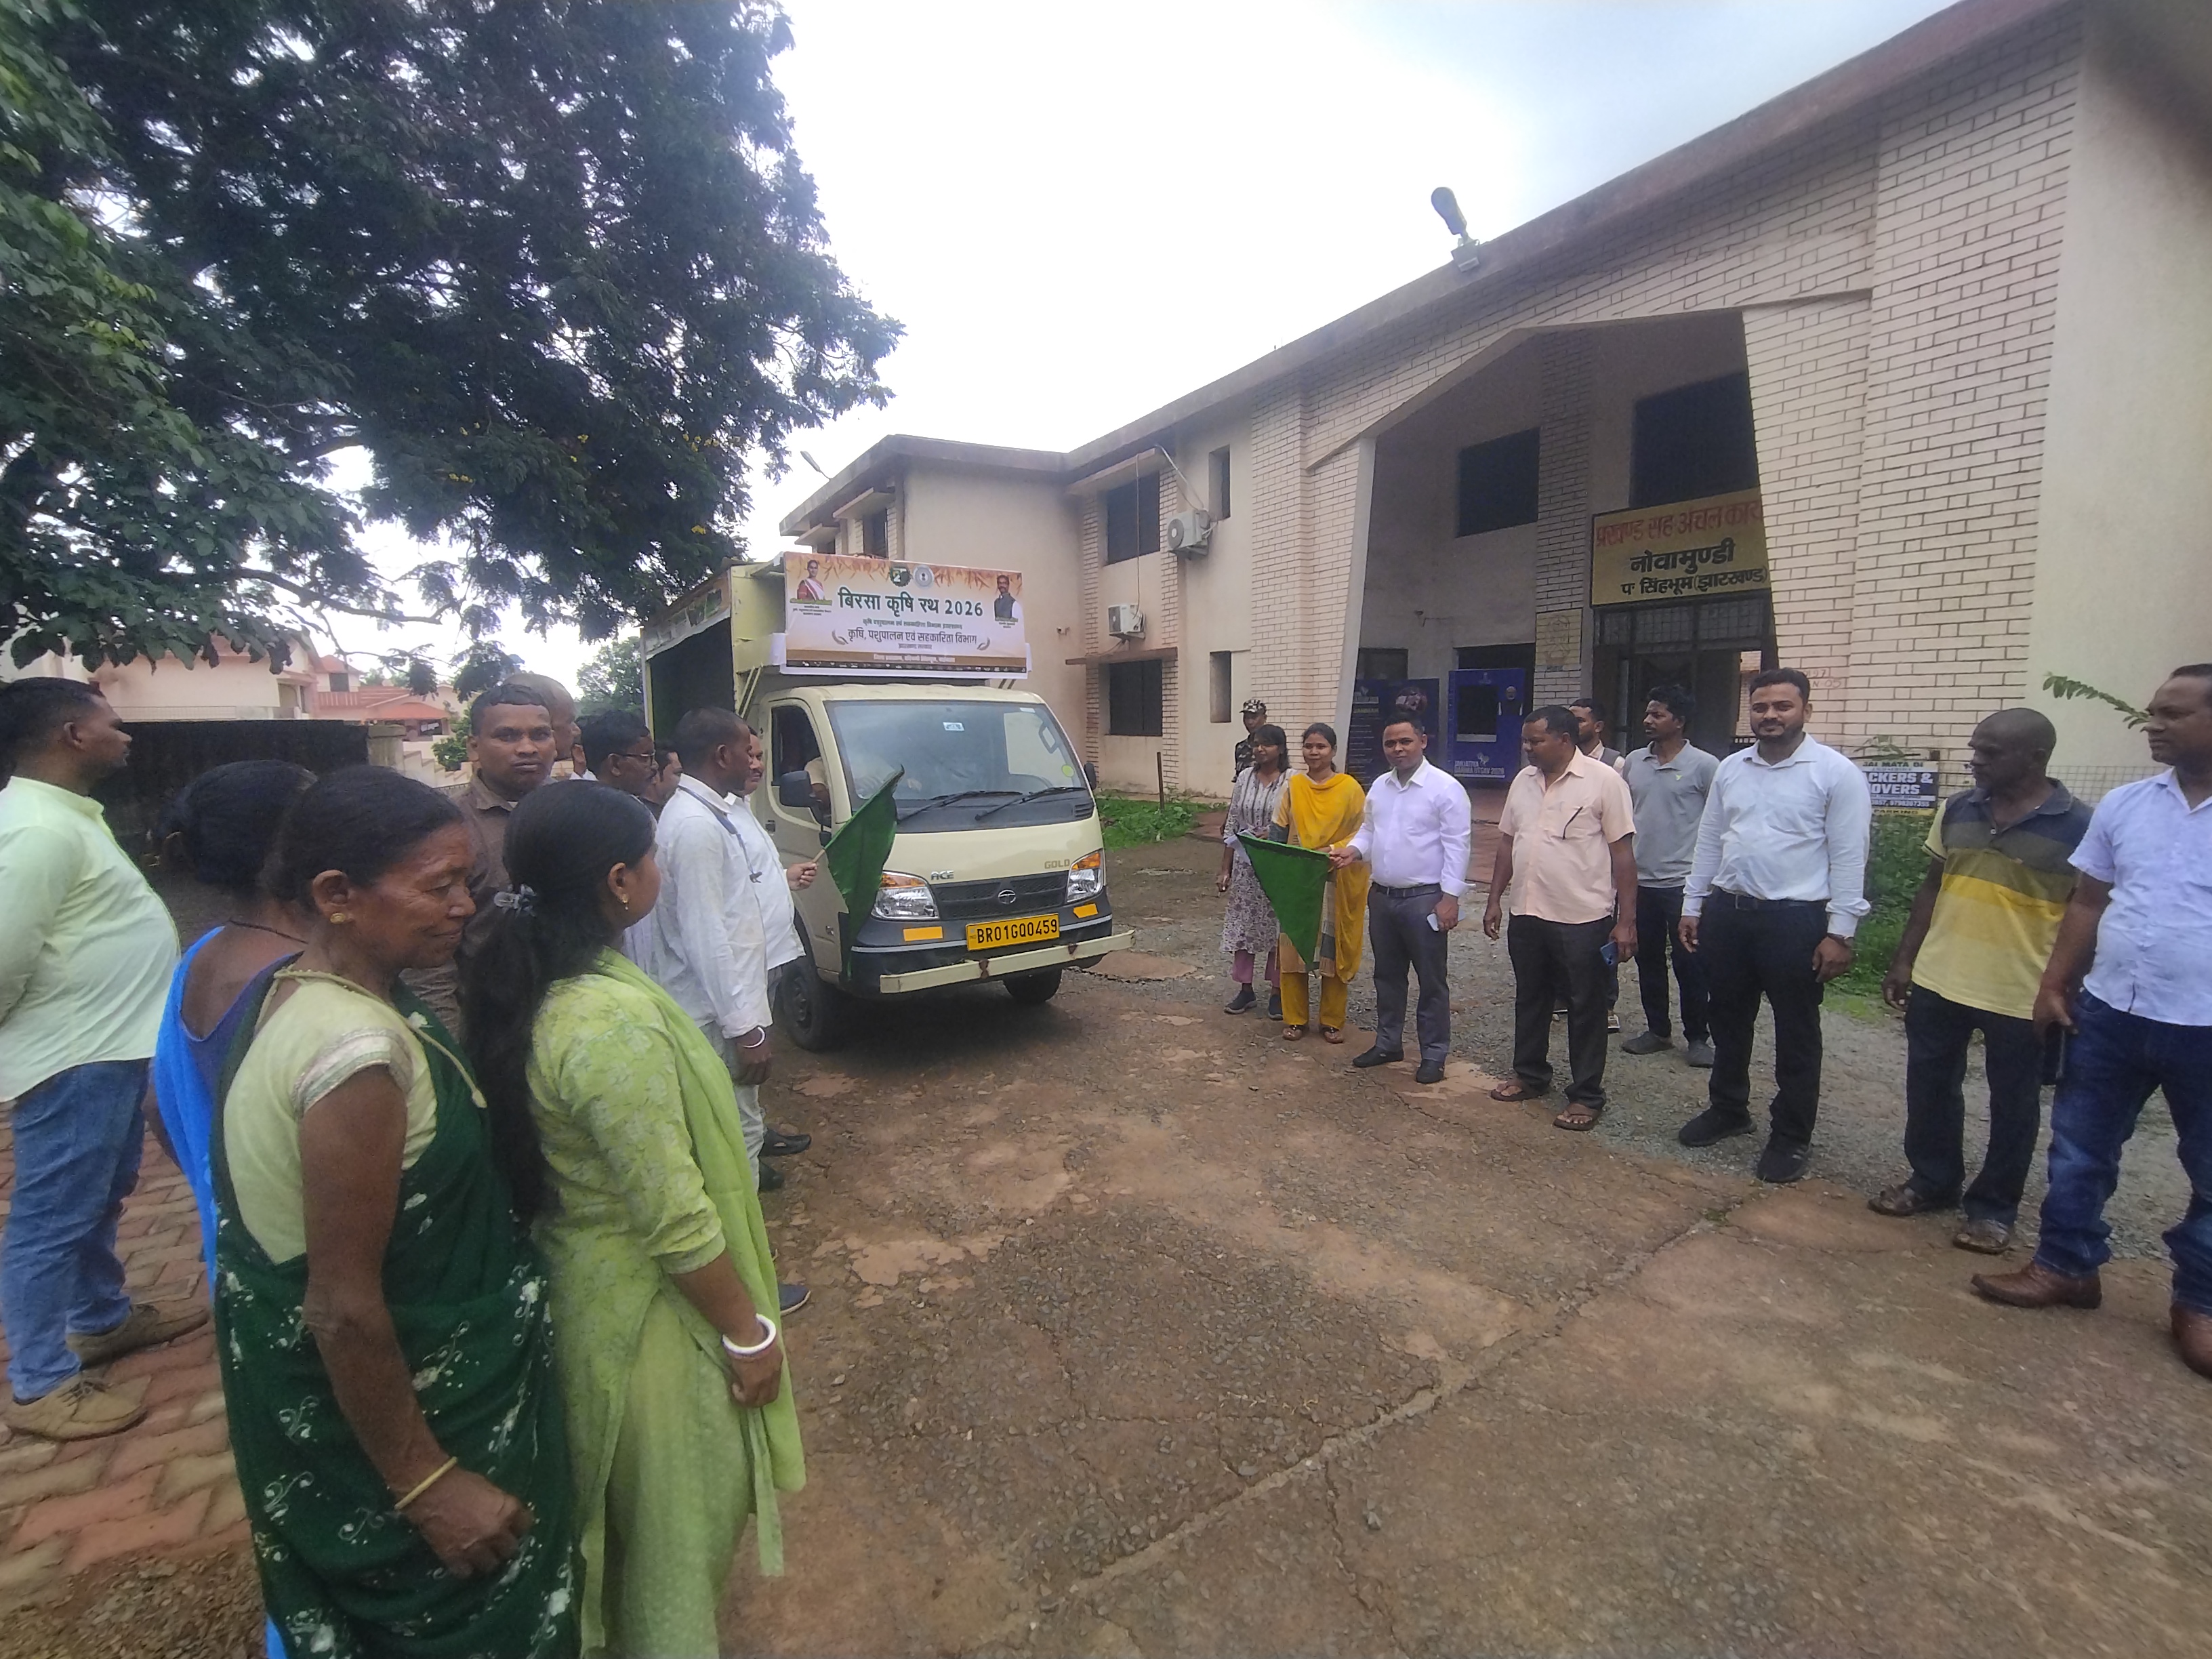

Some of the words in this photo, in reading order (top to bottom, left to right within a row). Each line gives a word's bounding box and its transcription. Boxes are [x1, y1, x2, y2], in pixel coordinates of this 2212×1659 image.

[1648, 514, 1674, 539] सह
[1630, 537, 1736, 575] नोवामुण्डी
[838, 586, 881, 610] बिरसा
[885, 591, 914, 617] कृषि
[918, 598, 939, 613] रथ
[945, 599, 983, 617] 2026
[848, 628, 867, 642] कृषि,
[868, 630, 903, 642] पशुपालन
[905, 630, 915, 641] एवं
[918, 631, 954, 643] सहकारिता
[955, 632, 977, 644] विभाग
[1868, 772, 1917, 783] CKERS
[1921, 773, 1933, 783] &
[1870, 783, 1921, 794] OVERS
[1044, 859, 1071, 869] GOLD
[930, 870, 954, 881] ACE
[977, 919, 1057, 943] BR01GQ0459
